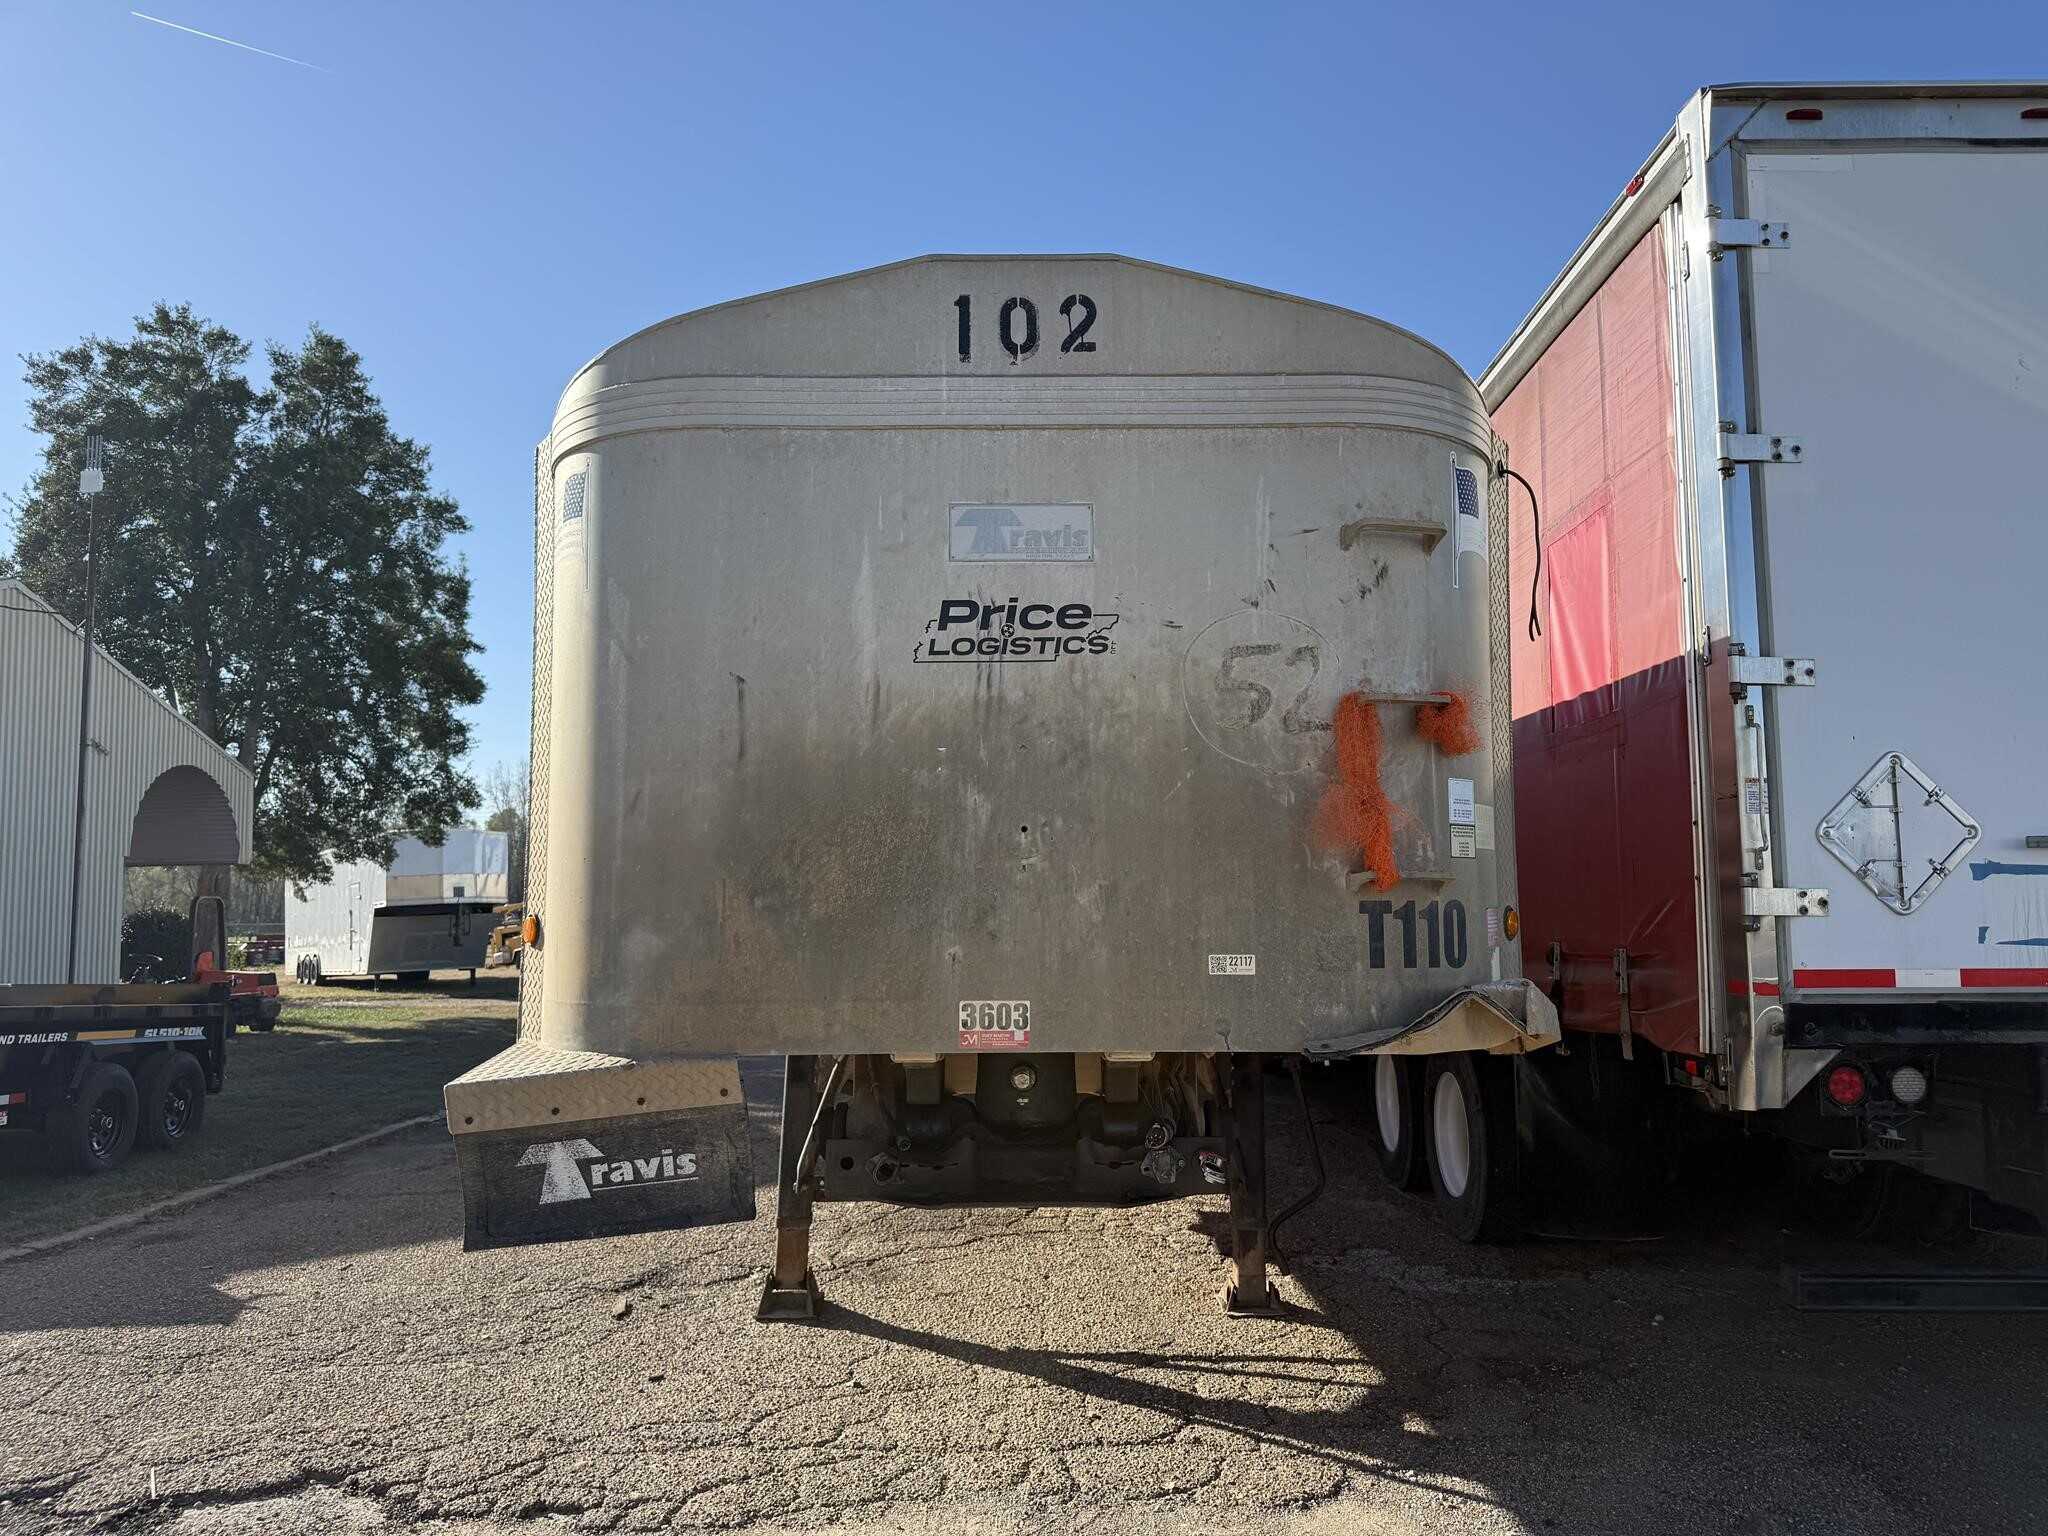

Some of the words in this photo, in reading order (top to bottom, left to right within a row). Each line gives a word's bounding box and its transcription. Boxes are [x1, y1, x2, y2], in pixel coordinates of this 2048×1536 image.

[954, 294, 1097, 357] 102
[955, 508, 1089, 553] Travis
[937, 597, 1093, 631] Price
[928, 635, 1110, 656] LOGISTICS
[1359, 899, 1467, 969] T110
[1228, 955, 1253, 967] 22117
[961, 1002, 1029, 1031] 3603
[18, 1031, 69, 1044] TRAILERS
[515, 1138, 697, 1205] Travis
